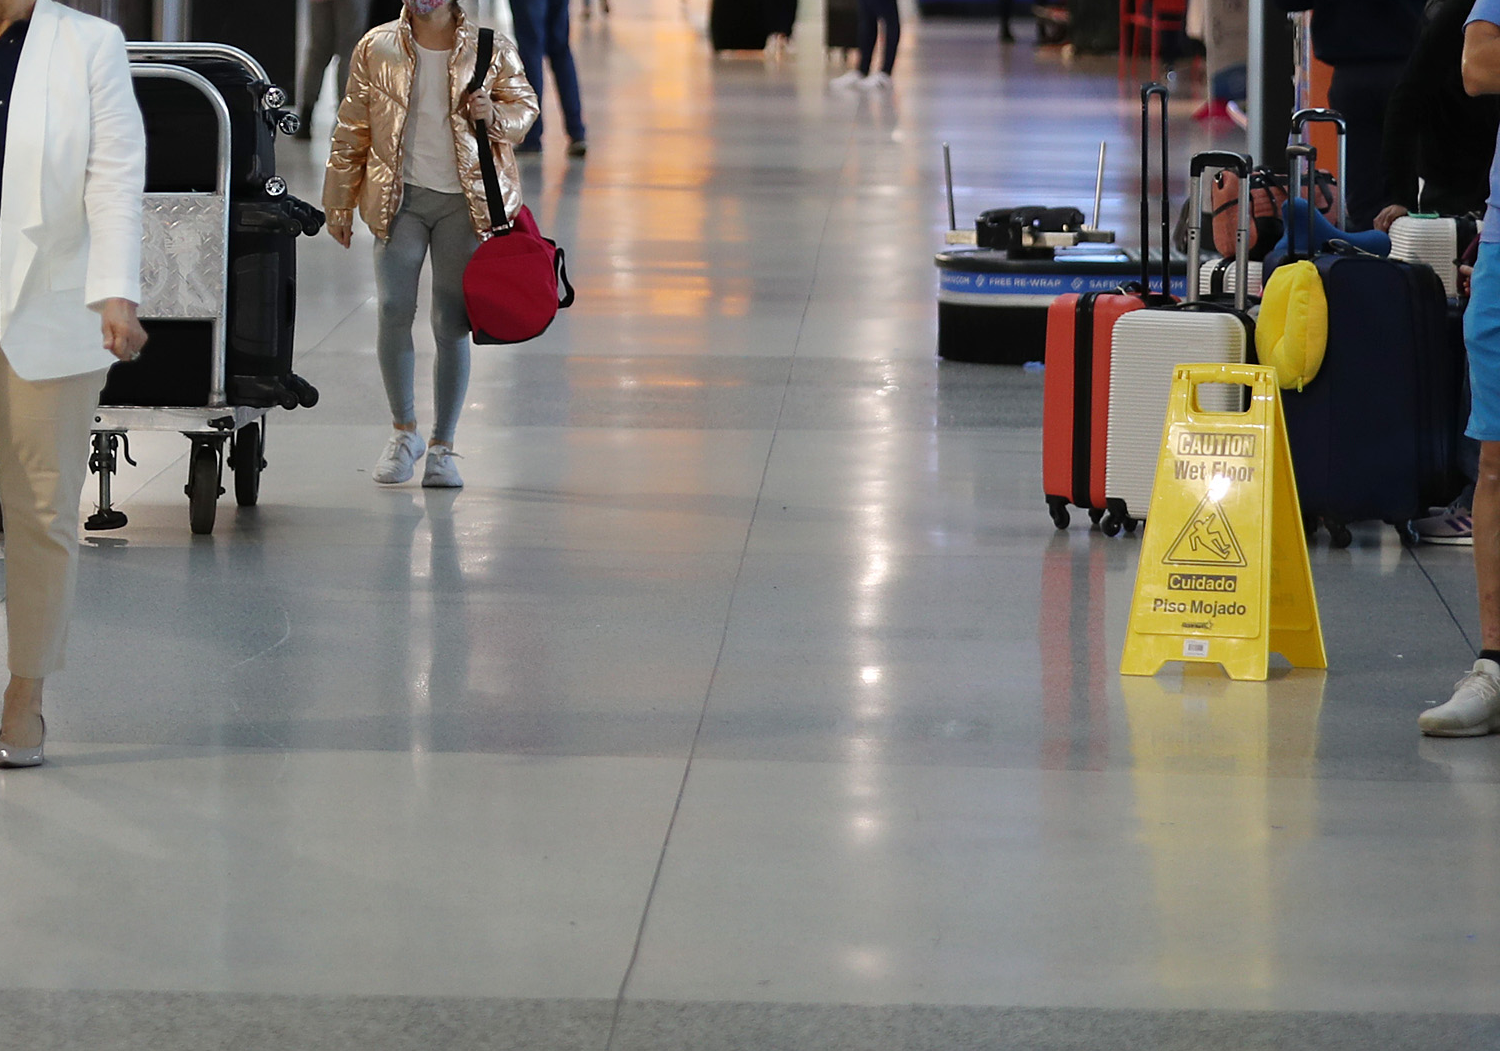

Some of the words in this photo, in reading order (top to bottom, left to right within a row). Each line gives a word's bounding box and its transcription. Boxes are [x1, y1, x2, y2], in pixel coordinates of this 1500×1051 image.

[989, 276, 1012, 287] FREE
[1014, 276, 1062, 288] RE-WRAP
[1178, 433, 1255, 457] CAUTION
[1174, 460, 1207, 480] Wet
[1169, 573, 1236, 592] Cuidado
[1153, 598, 1187, 614] Piso
[1189, 599, 1247, 618] Mojado
